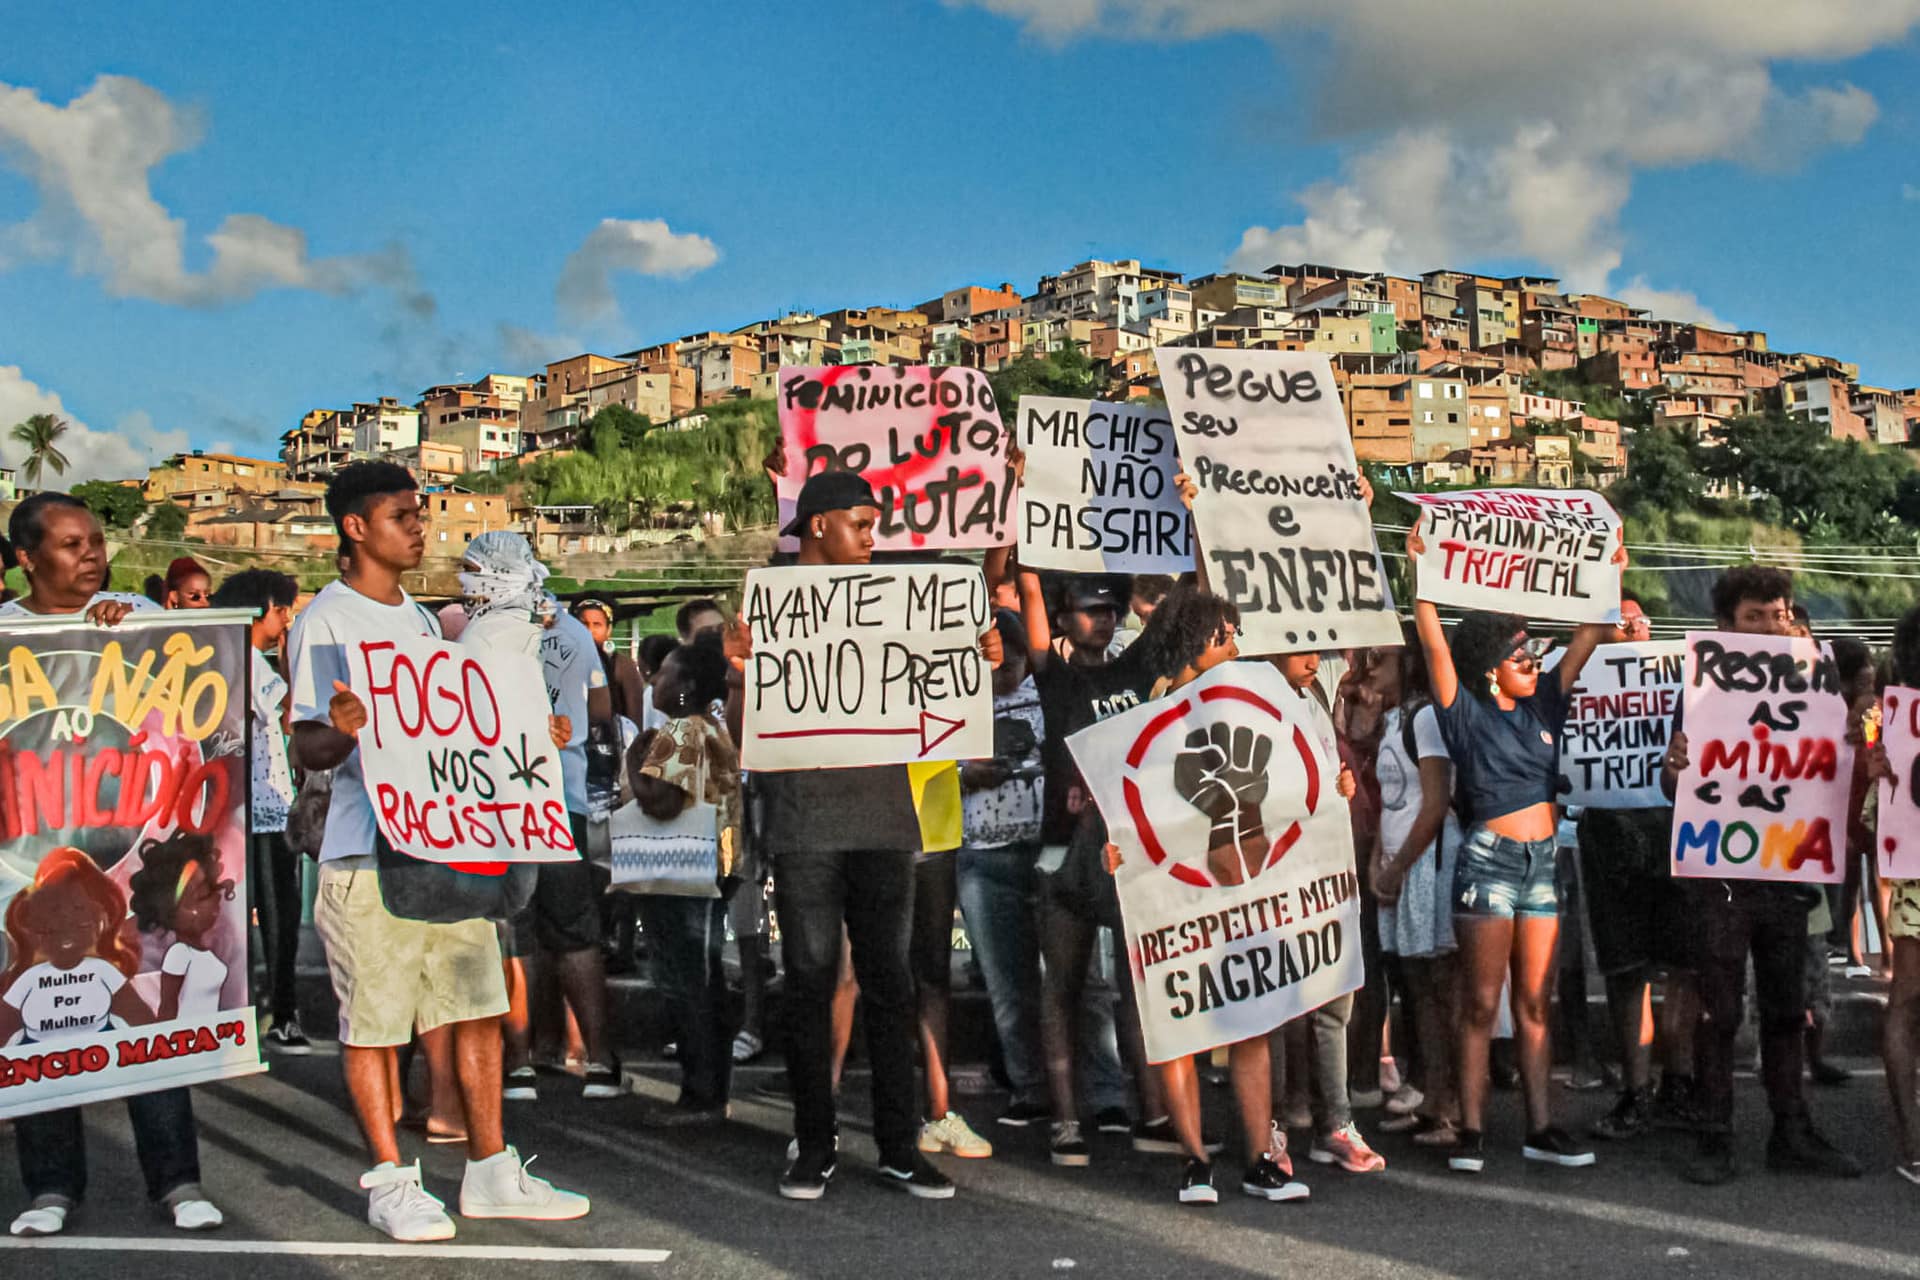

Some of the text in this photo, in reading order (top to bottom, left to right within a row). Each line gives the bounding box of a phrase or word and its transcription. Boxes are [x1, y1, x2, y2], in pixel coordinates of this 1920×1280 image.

[1027, 408, 1179, 457] MACHIS
[878, 465, 1016, 541] LUTA!
[1081, 453, 1164, 500] NÃO
[1209, 547, 1386, 614] ENFIE
[1439, 540, 1590, 600] TROPICAL
[748, 571, 989, 643] AVANTE MEU
[89, 632, 228, 741] NÃO
[359, 640, 502, 749] FOGO
[755, 639, 981, 716] POVO PRETO
[1605, 655, 1685, 688] TAN
[51, 708, 94, 741] AO
[1748, 701, 1808, 732] AS
[428, 747, 496, 800] NOS
[1676, 817, 1836, 874] MONA
[1140, 870, 1357, 967] RESPEITE MEU
[38, 971, 96, 990] Mulher
[1165, 919, 1342, 1019] SAGRADO
[40, 1012, 97, 1032] Mulher
[54, 994, 82, 1009] Por
